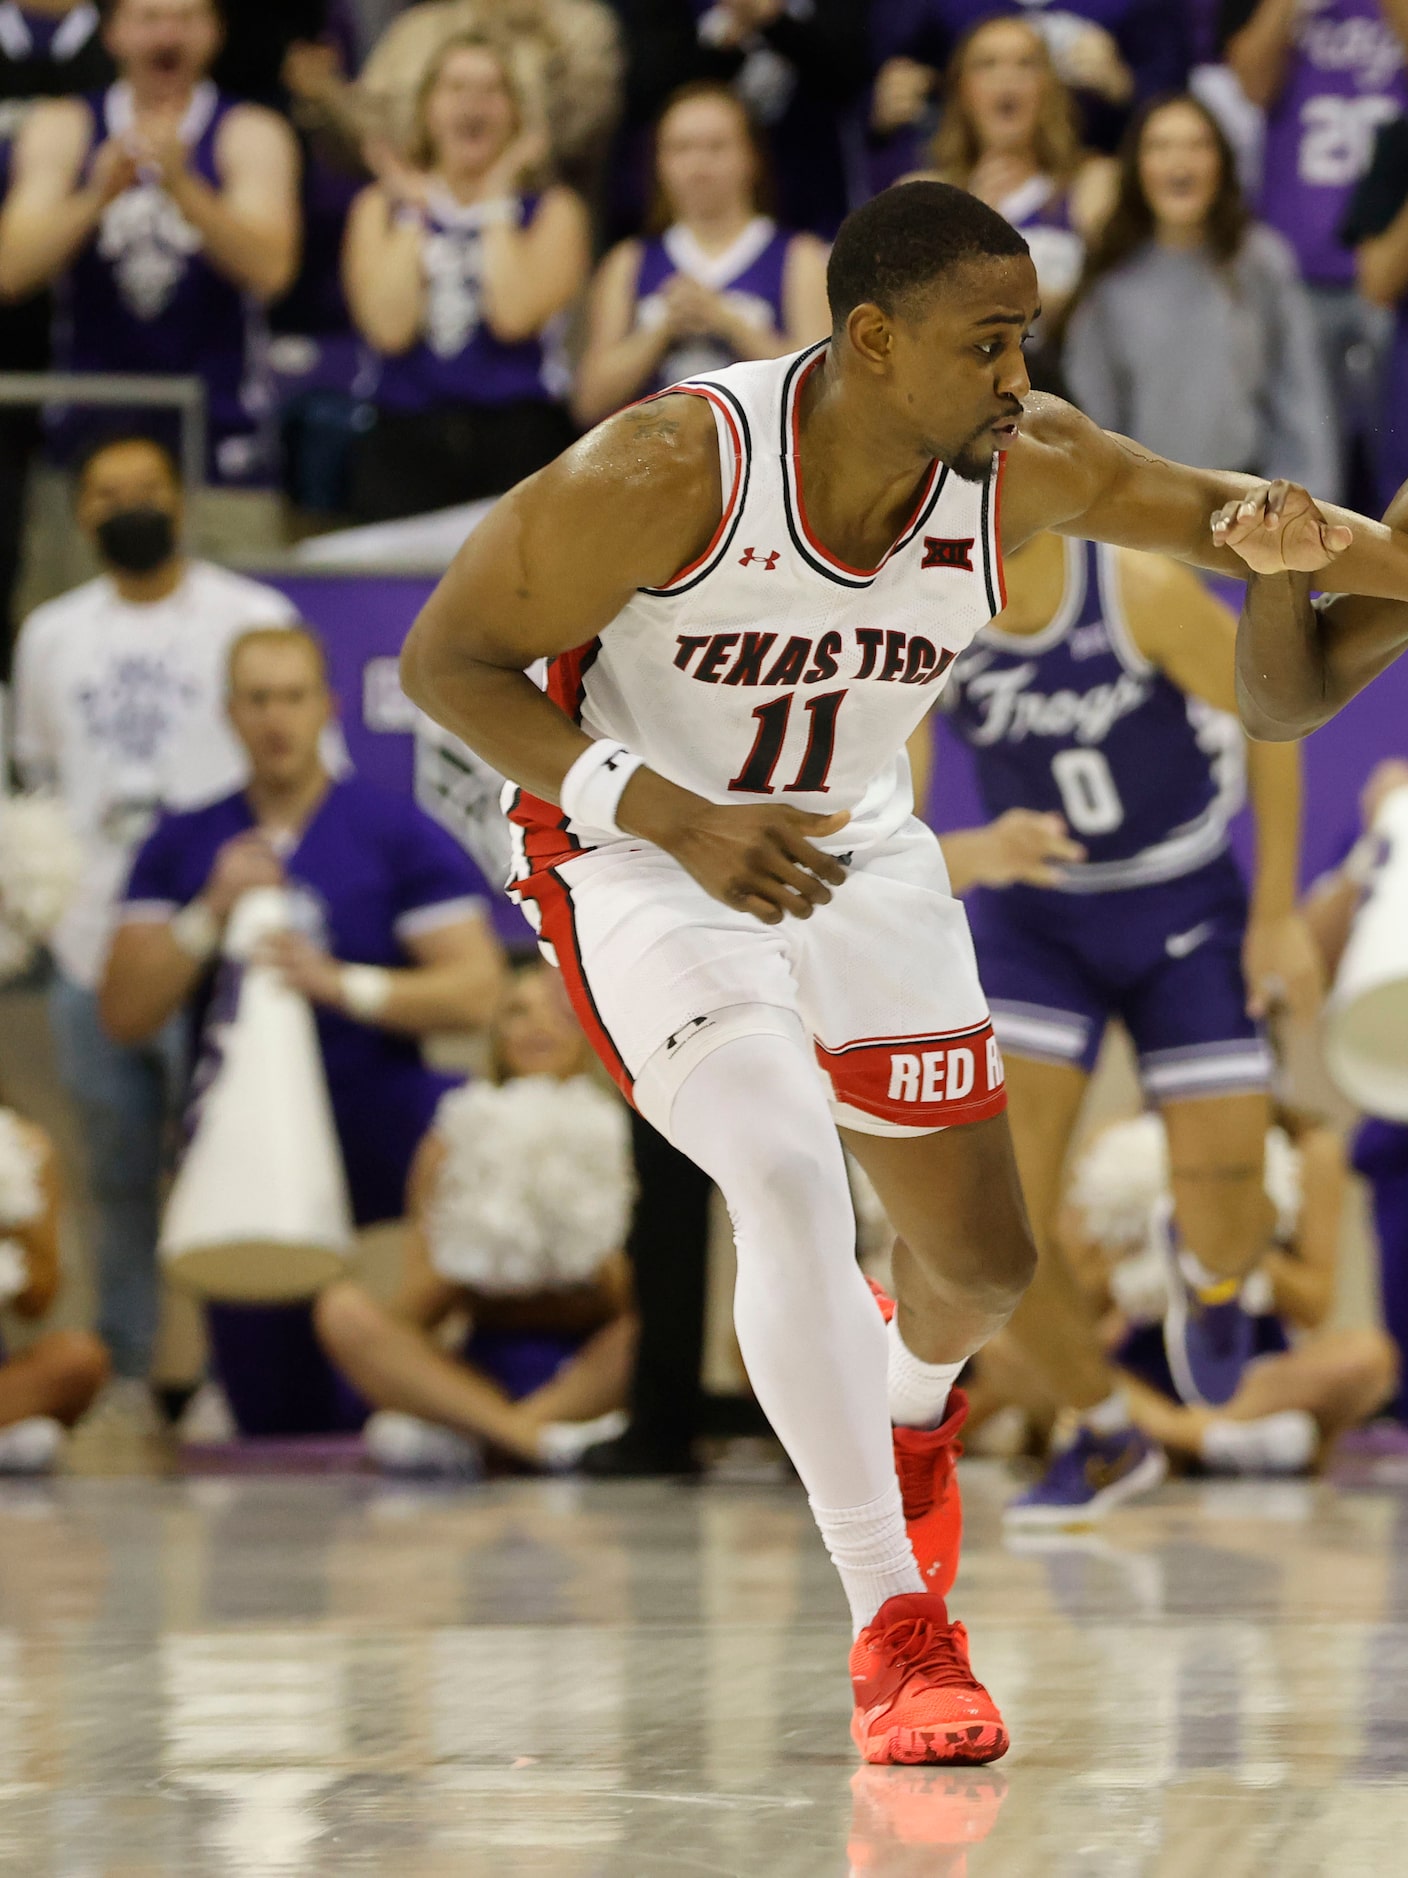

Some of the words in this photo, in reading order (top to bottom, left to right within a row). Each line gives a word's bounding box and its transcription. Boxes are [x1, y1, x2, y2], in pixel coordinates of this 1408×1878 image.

[673, 631, 843, 686] TEXAS
[728, 688, 849, 794] 11
[1051, 747, 1124, 836] 0
[887, 1048, 975, 1103] RED
